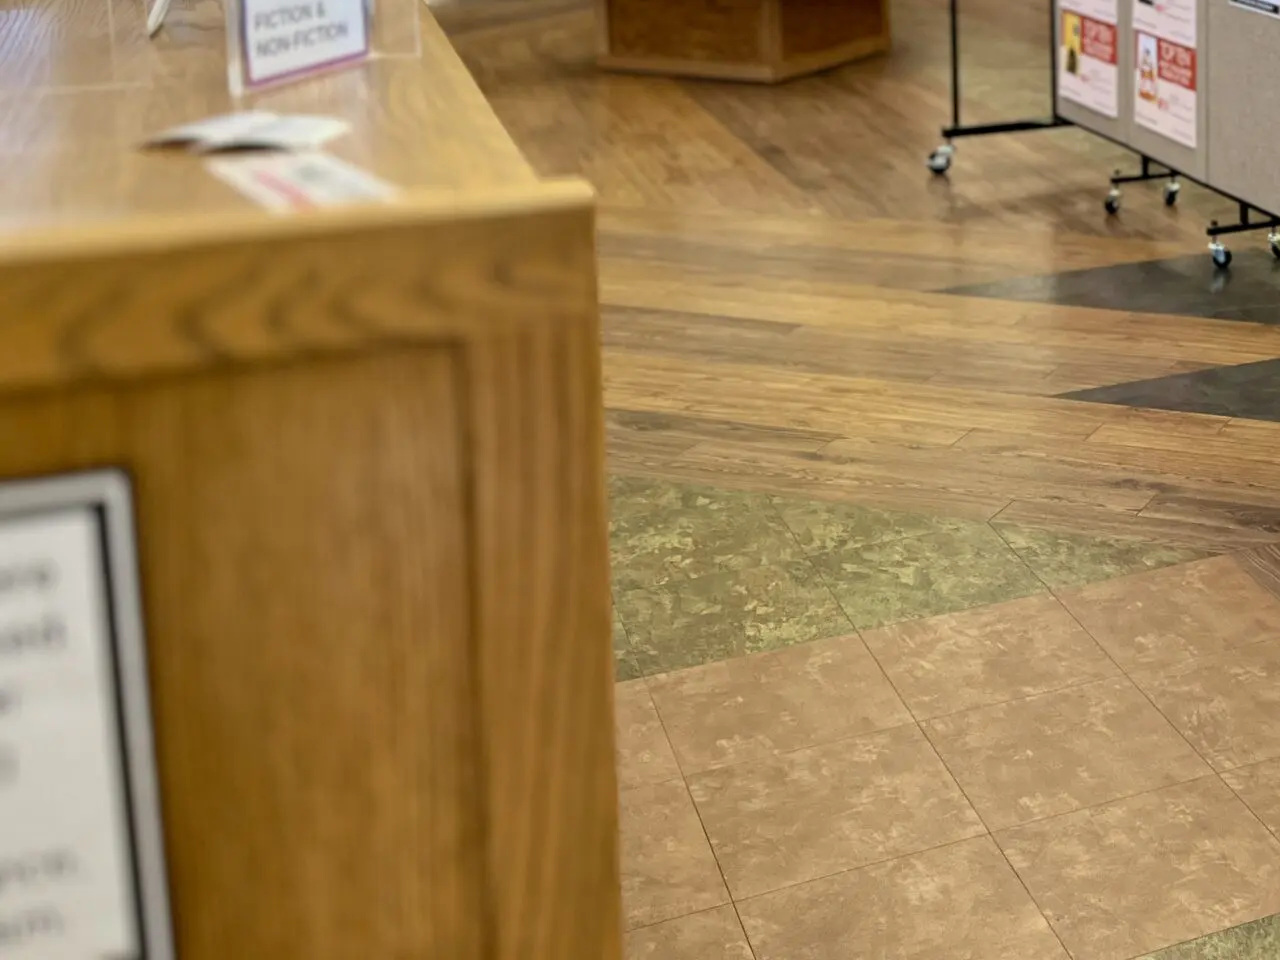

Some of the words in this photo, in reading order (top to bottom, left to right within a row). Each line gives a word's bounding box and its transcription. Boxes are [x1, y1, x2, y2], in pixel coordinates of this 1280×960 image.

[254, 5, 314, 31] FICTION
[315, 4, 326, 20] &
[255, 24, 349, 58] NON-FICTION
